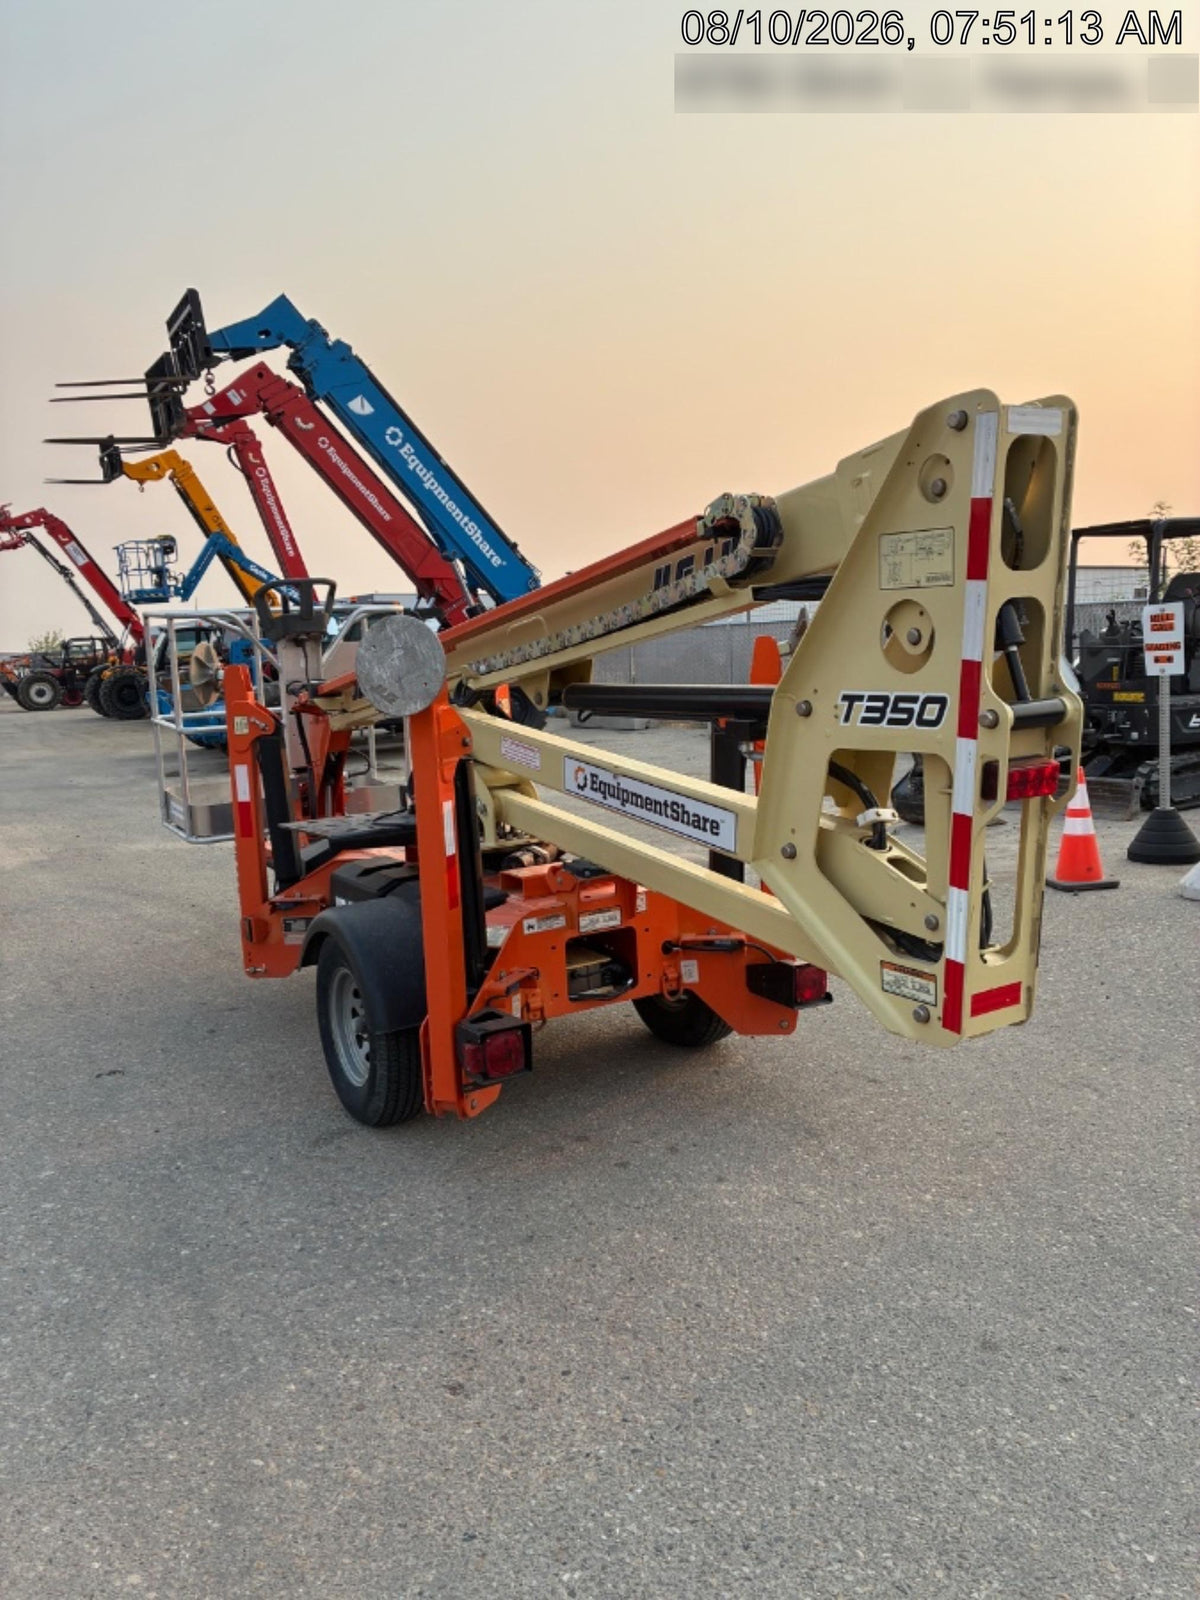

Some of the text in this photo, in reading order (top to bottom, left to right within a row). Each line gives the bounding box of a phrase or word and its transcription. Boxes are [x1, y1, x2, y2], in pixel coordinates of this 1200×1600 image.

[400, 443, 502, 567] EquipmentShare
[839, 691, 949, 730] T350
[589, 772, 720, 836] EquipmentShare
